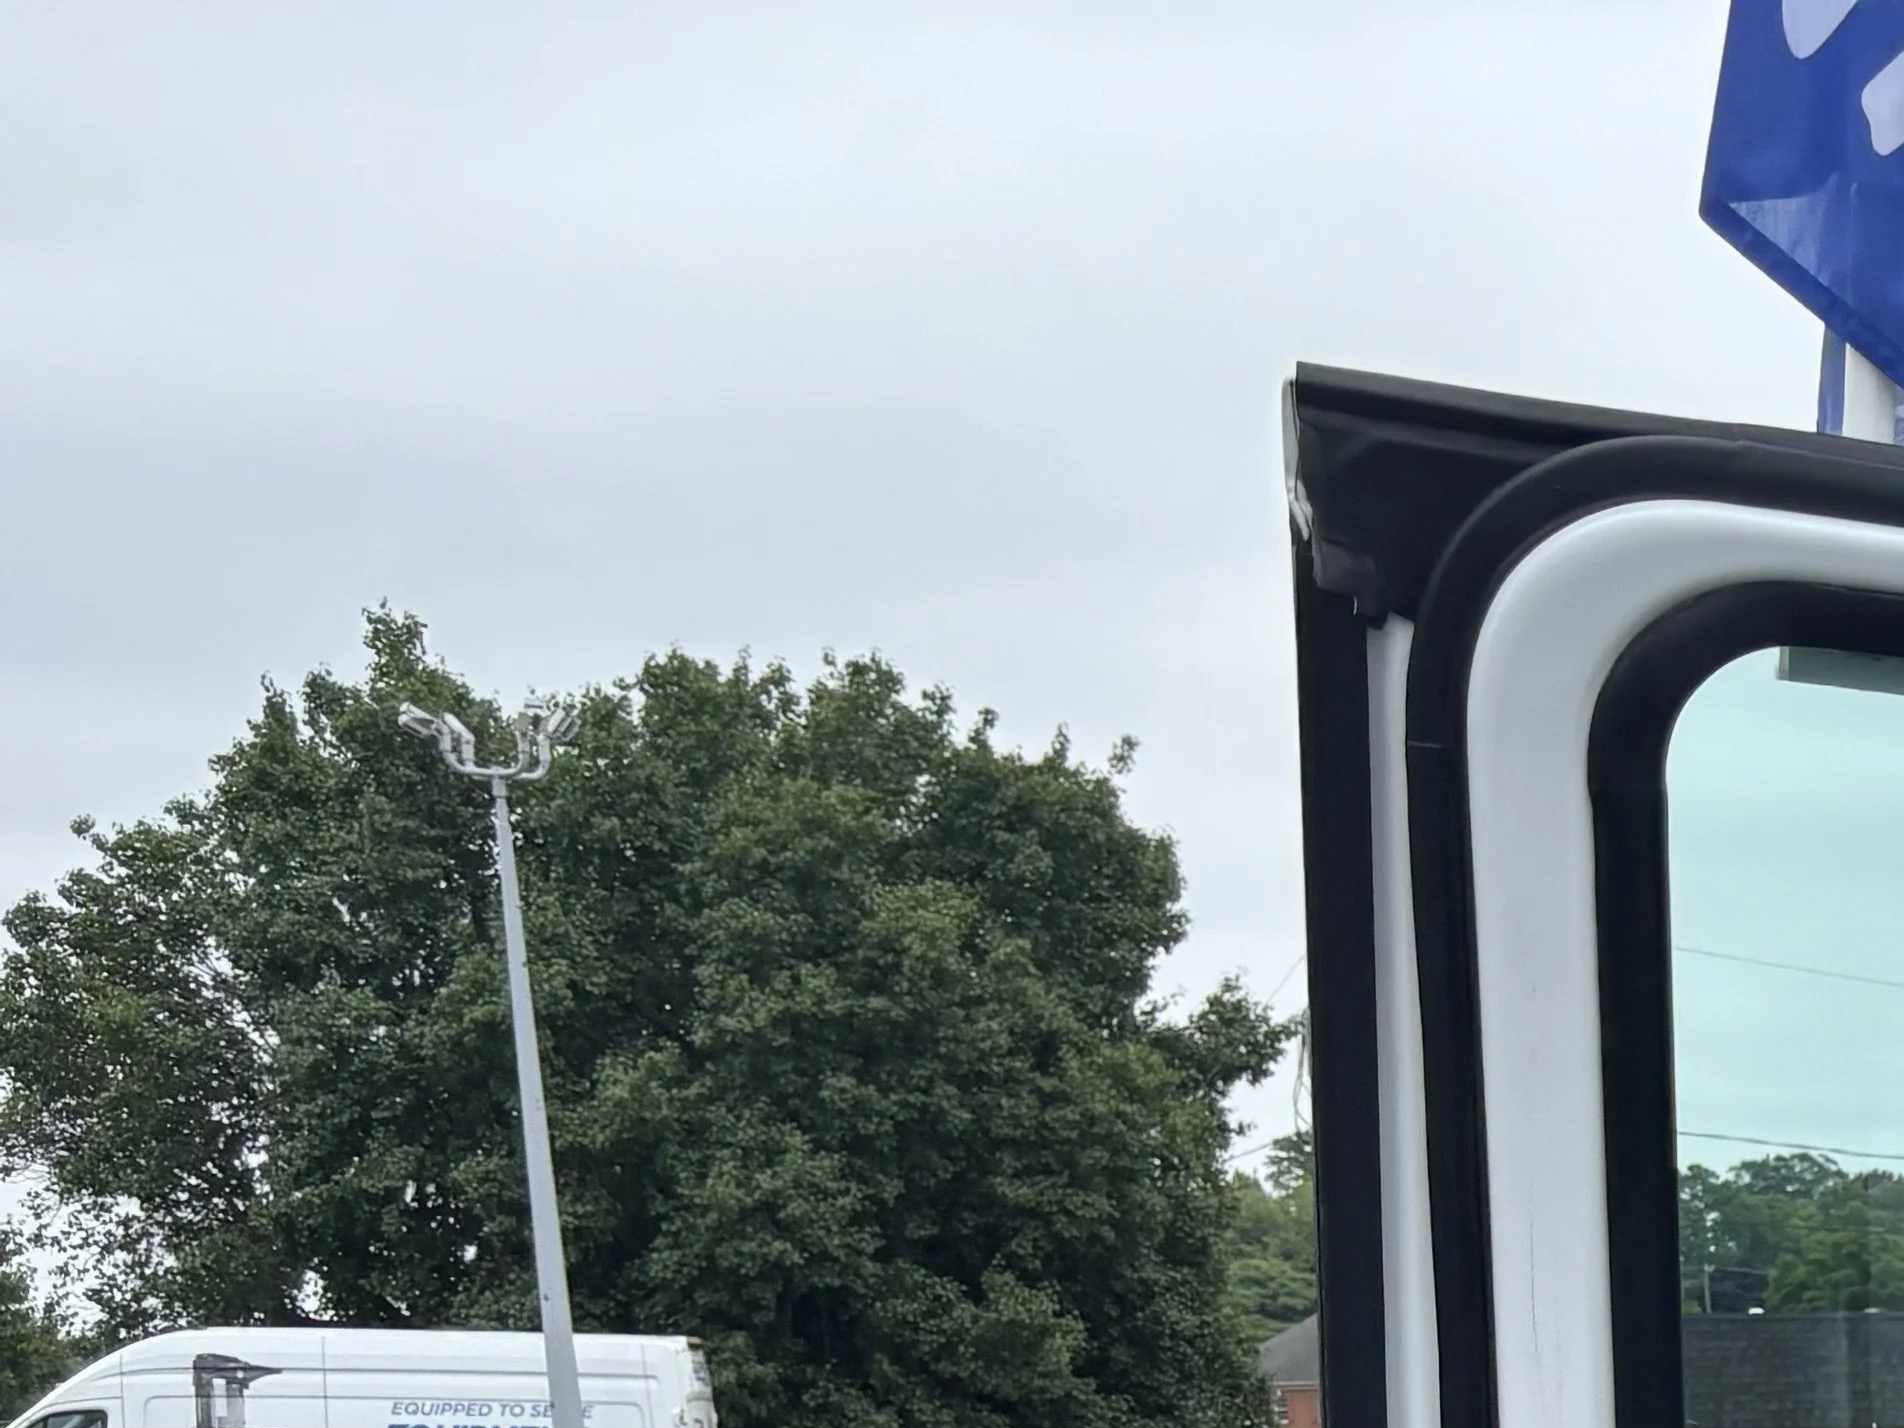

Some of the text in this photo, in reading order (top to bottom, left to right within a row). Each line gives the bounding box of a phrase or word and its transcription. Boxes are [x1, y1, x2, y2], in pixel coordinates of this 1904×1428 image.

[391, 1402, 594, 1420] EQUIPPED TO SEE
